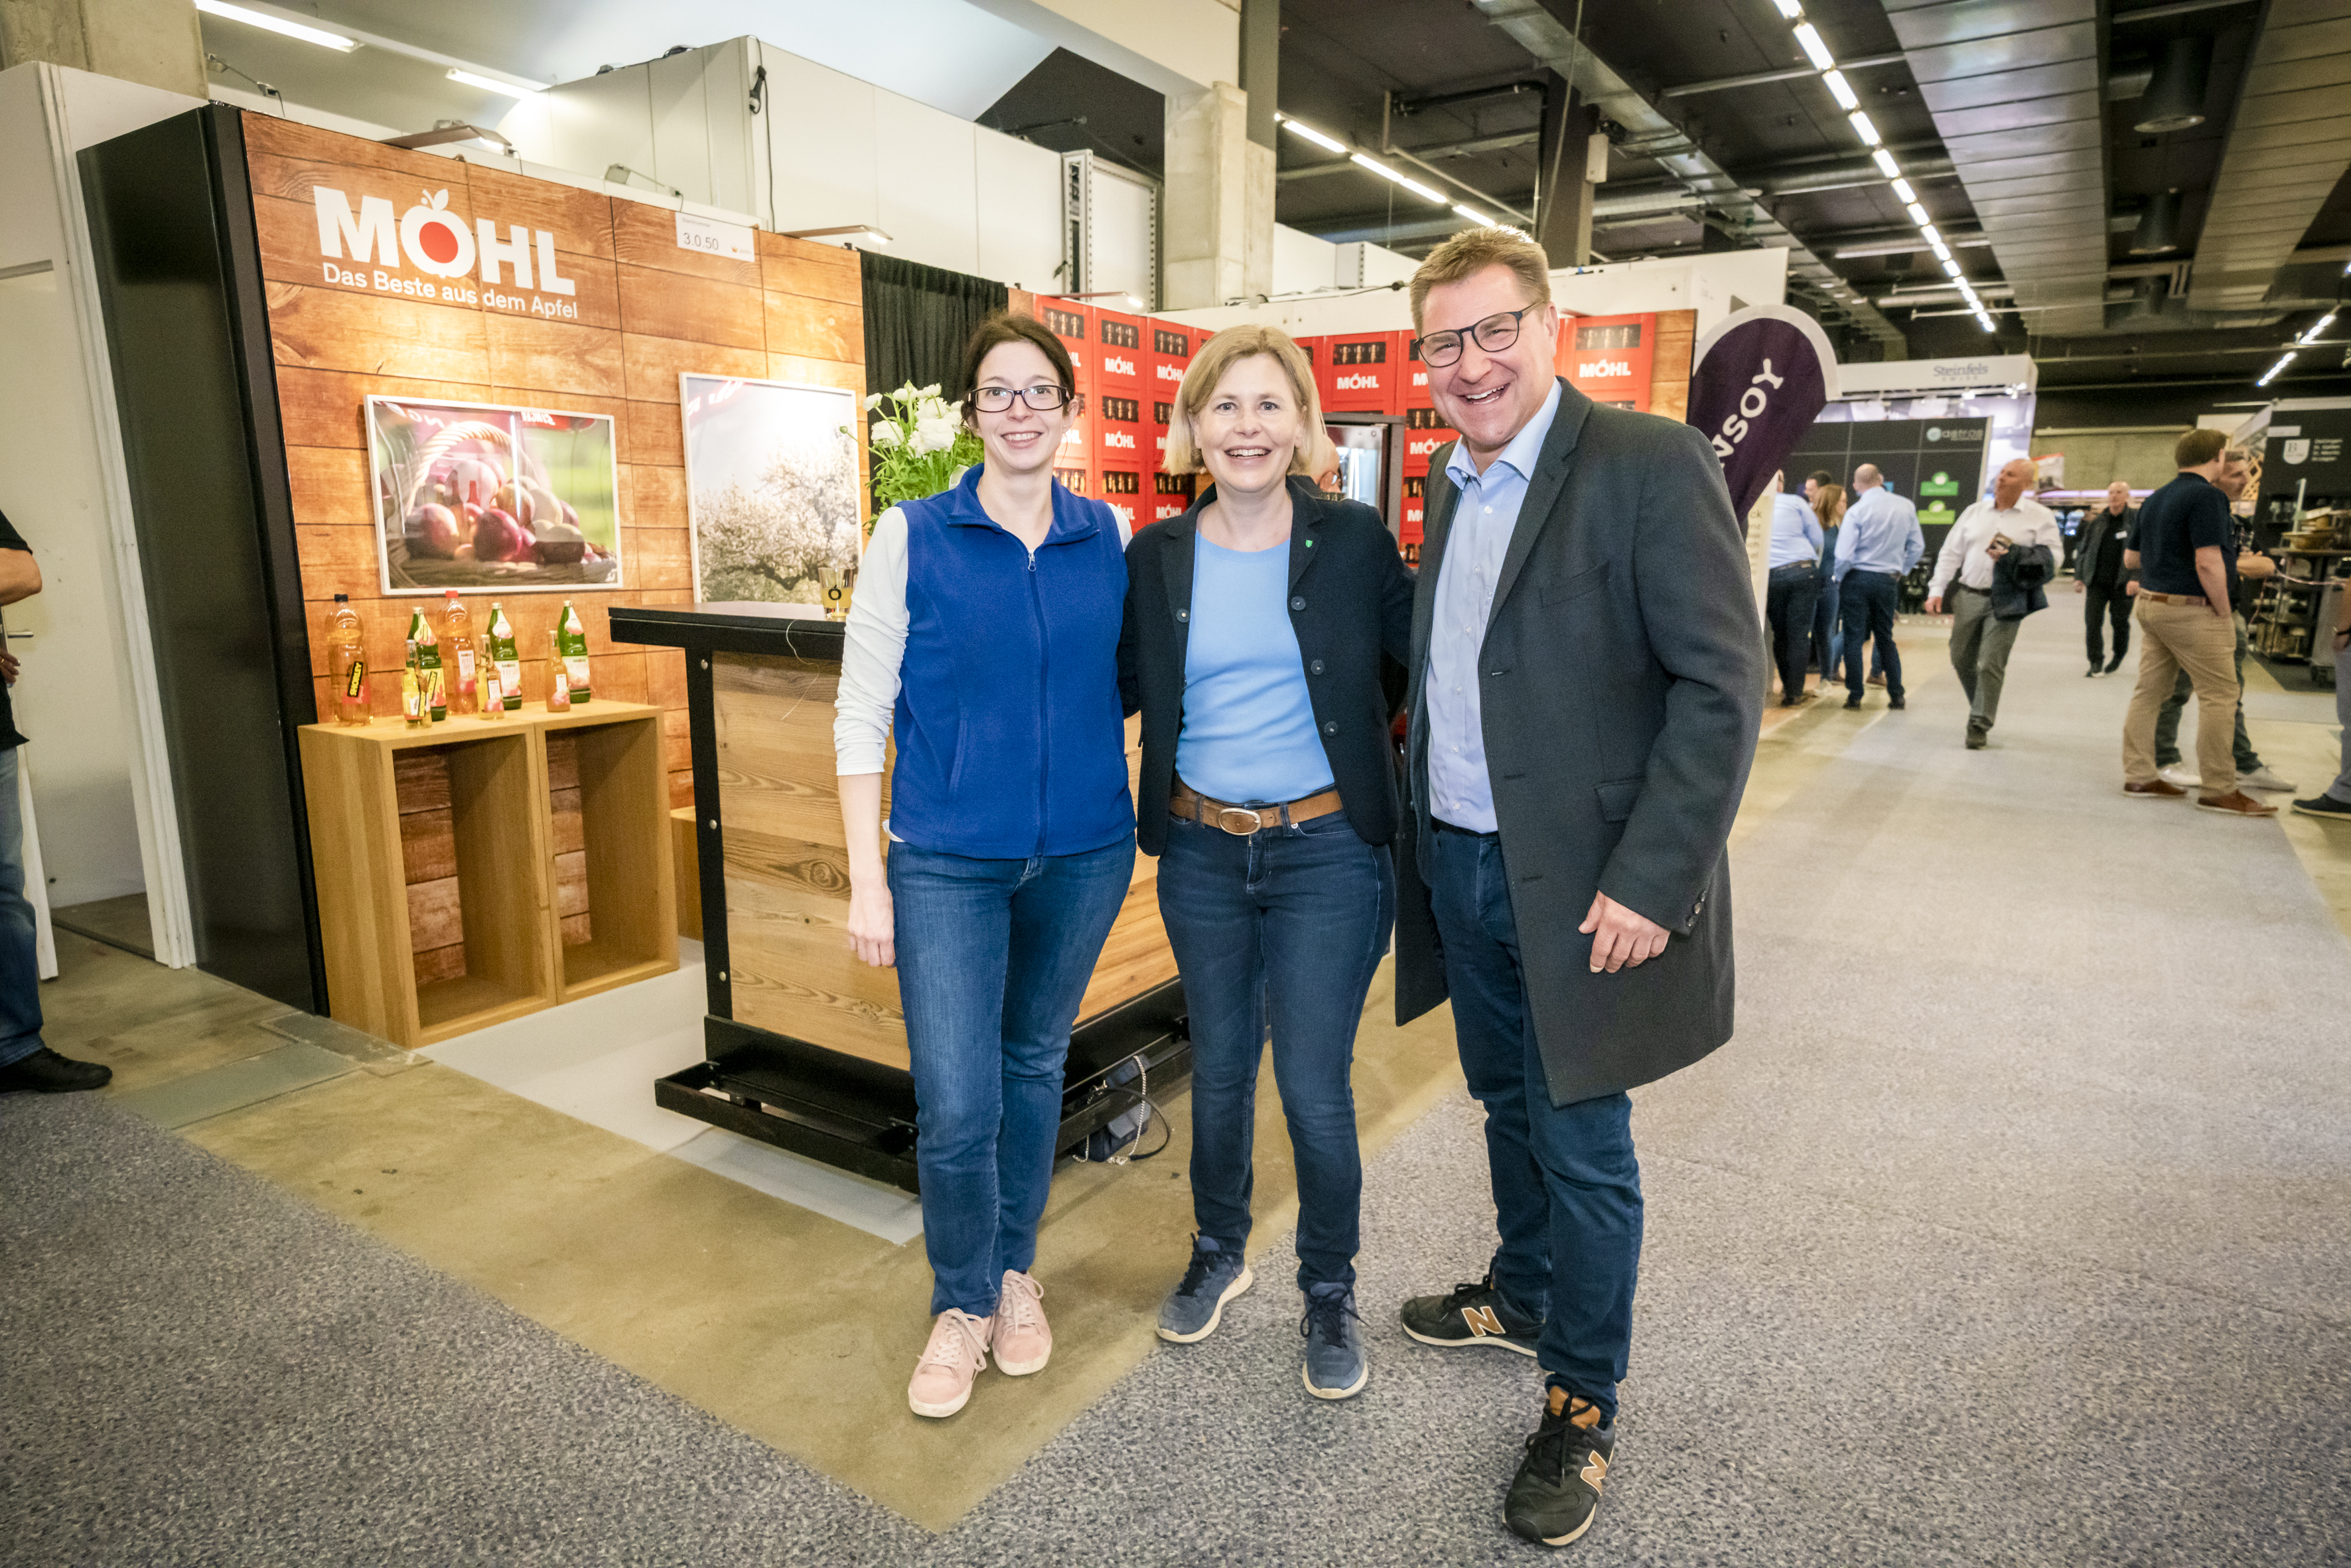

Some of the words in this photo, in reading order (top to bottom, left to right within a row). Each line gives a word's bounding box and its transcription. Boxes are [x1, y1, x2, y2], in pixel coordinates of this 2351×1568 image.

[313, 184, 576, 297] MÖHL
[683, 232, 719, 250] 3.0.50
[322, 262, 368, 289] Das
[373, 270, 436, 298] Beste
[441, 285, 478, 304] aus
[483, 289, 526, 311] dem
[532, 296, 578, 319] Apfel
[1105, 356, 1135, 376] MÖHL
[1579, 358, 1632, 378] MÖHL
[1337, 373, 1380, 390] MÖHL
[1105, 431, 1135, 449] MÖHL
[1461, 1306, 1506, 1337] N
[1580, 1450, 1608, 1496] N
